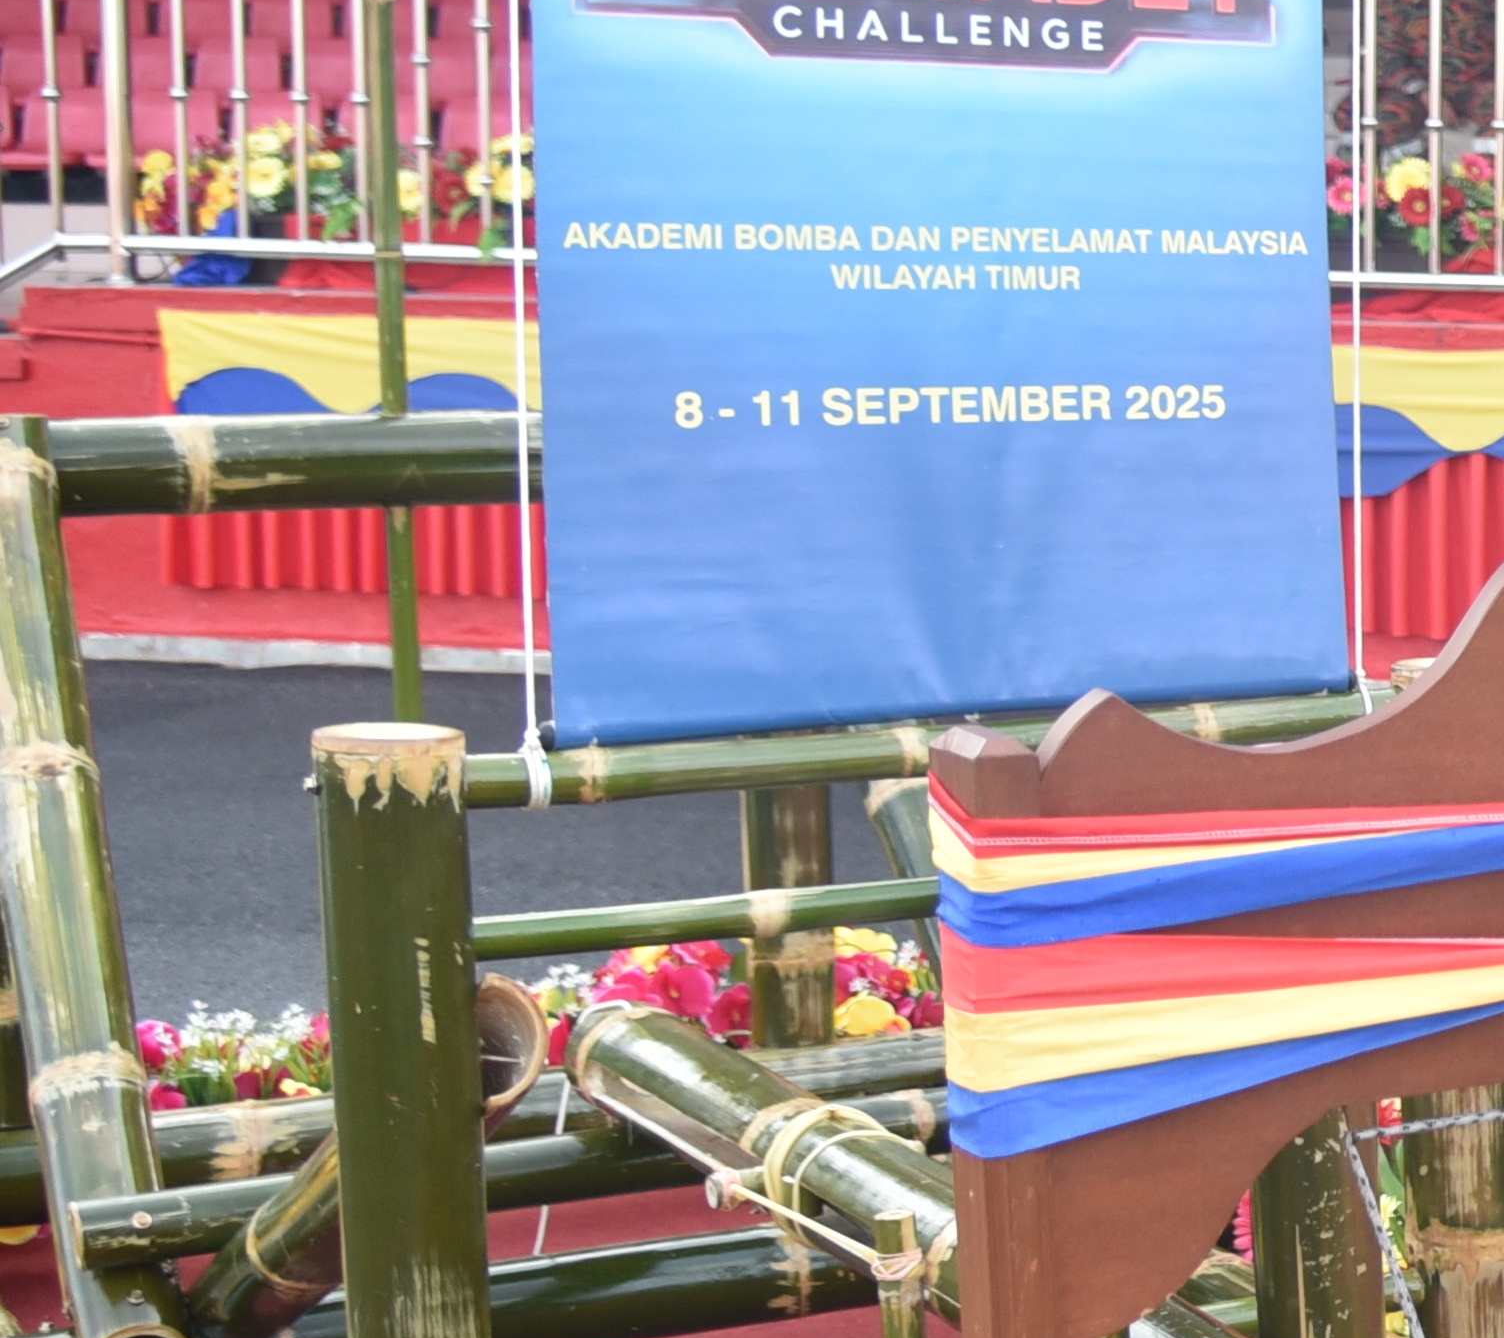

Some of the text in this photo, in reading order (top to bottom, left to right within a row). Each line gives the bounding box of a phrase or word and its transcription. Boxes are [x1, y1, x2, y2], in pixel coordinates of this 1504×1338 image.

[772, 4, 1106, 52] CHALLENGE
[563, 222, 1308, 256] AKADEMI BOMBA DAN PENYELAMAT MALAYSIA
[830, 263, 1081, 291] WILAYAH TIMUR
[674, 384, 1227, 429] 8 - 11 SEPTEMBER 2025
